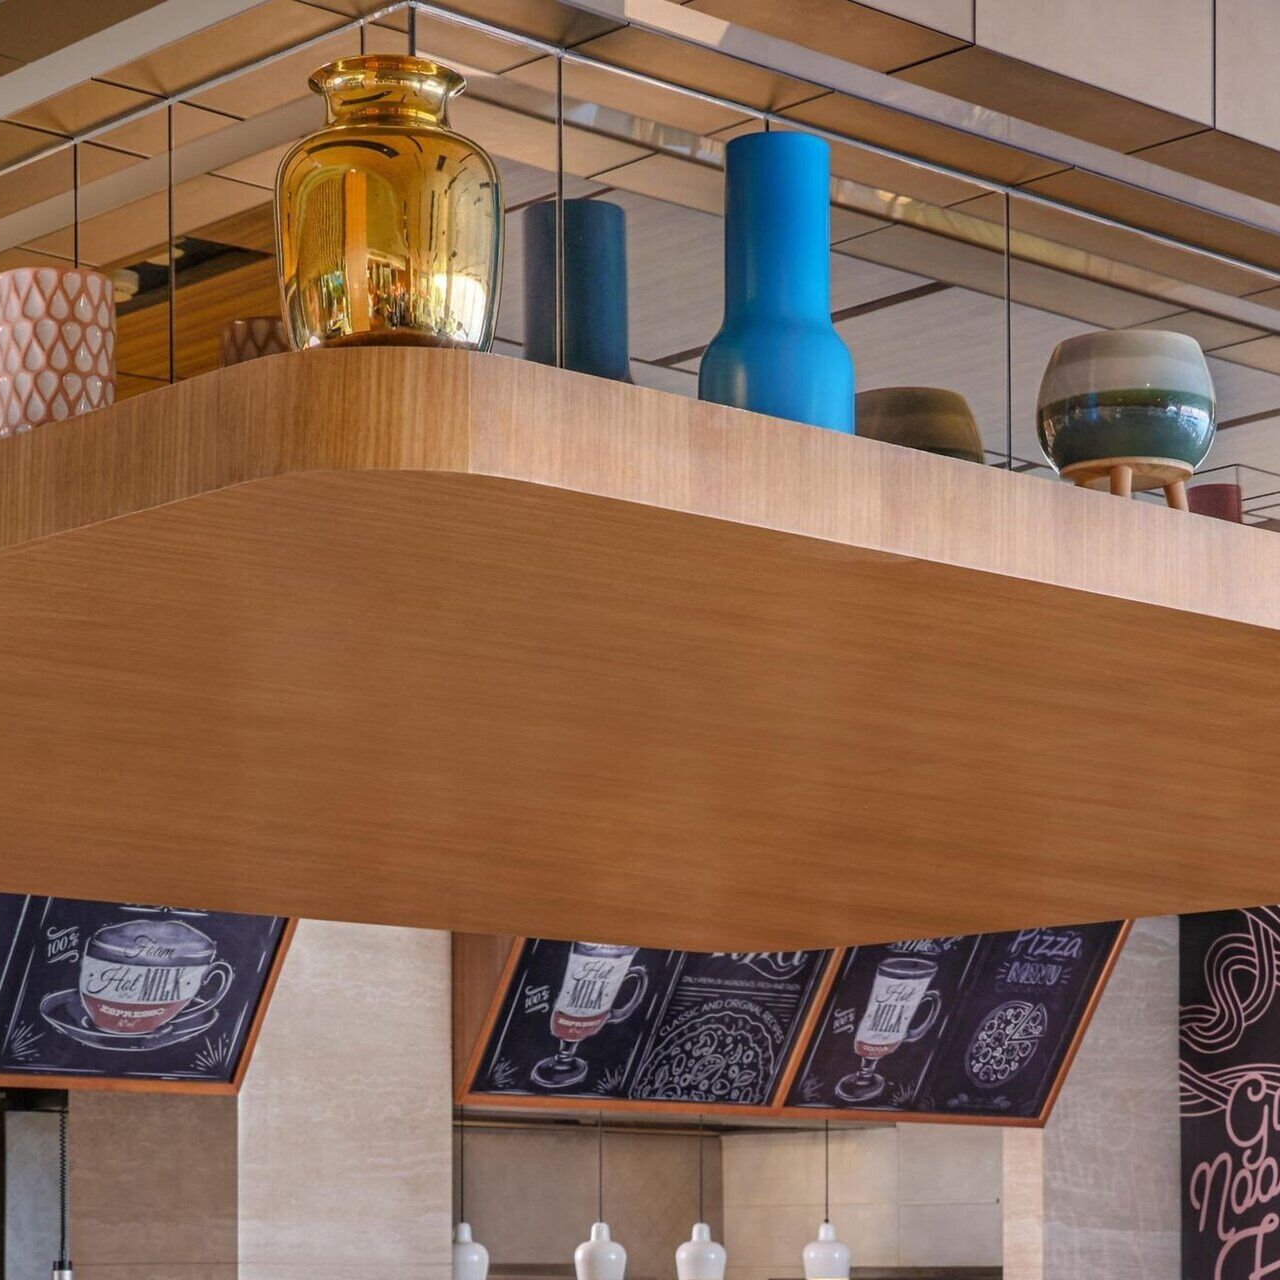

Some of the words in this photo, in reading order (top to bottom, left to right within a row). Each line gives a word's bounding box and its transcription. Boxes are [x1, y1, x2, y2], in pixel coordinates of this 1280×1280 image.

[47, 932, 79, 958] 100%
[123, 934, 178, 960] Foam
[86, 966, 142, 995] Hot
[137, 967, 186, 1002] MILK
[1006, 961, 1063, 986] MENU
[567, 979, 610, 1010] MILK
[98, 1004, 166, 1019] ESPRESSO
[659, 1005, 700, 1037] CLASSIC
[700, 999, 723, 1013] AND
[868, 1003, 909, 1034] MILK
